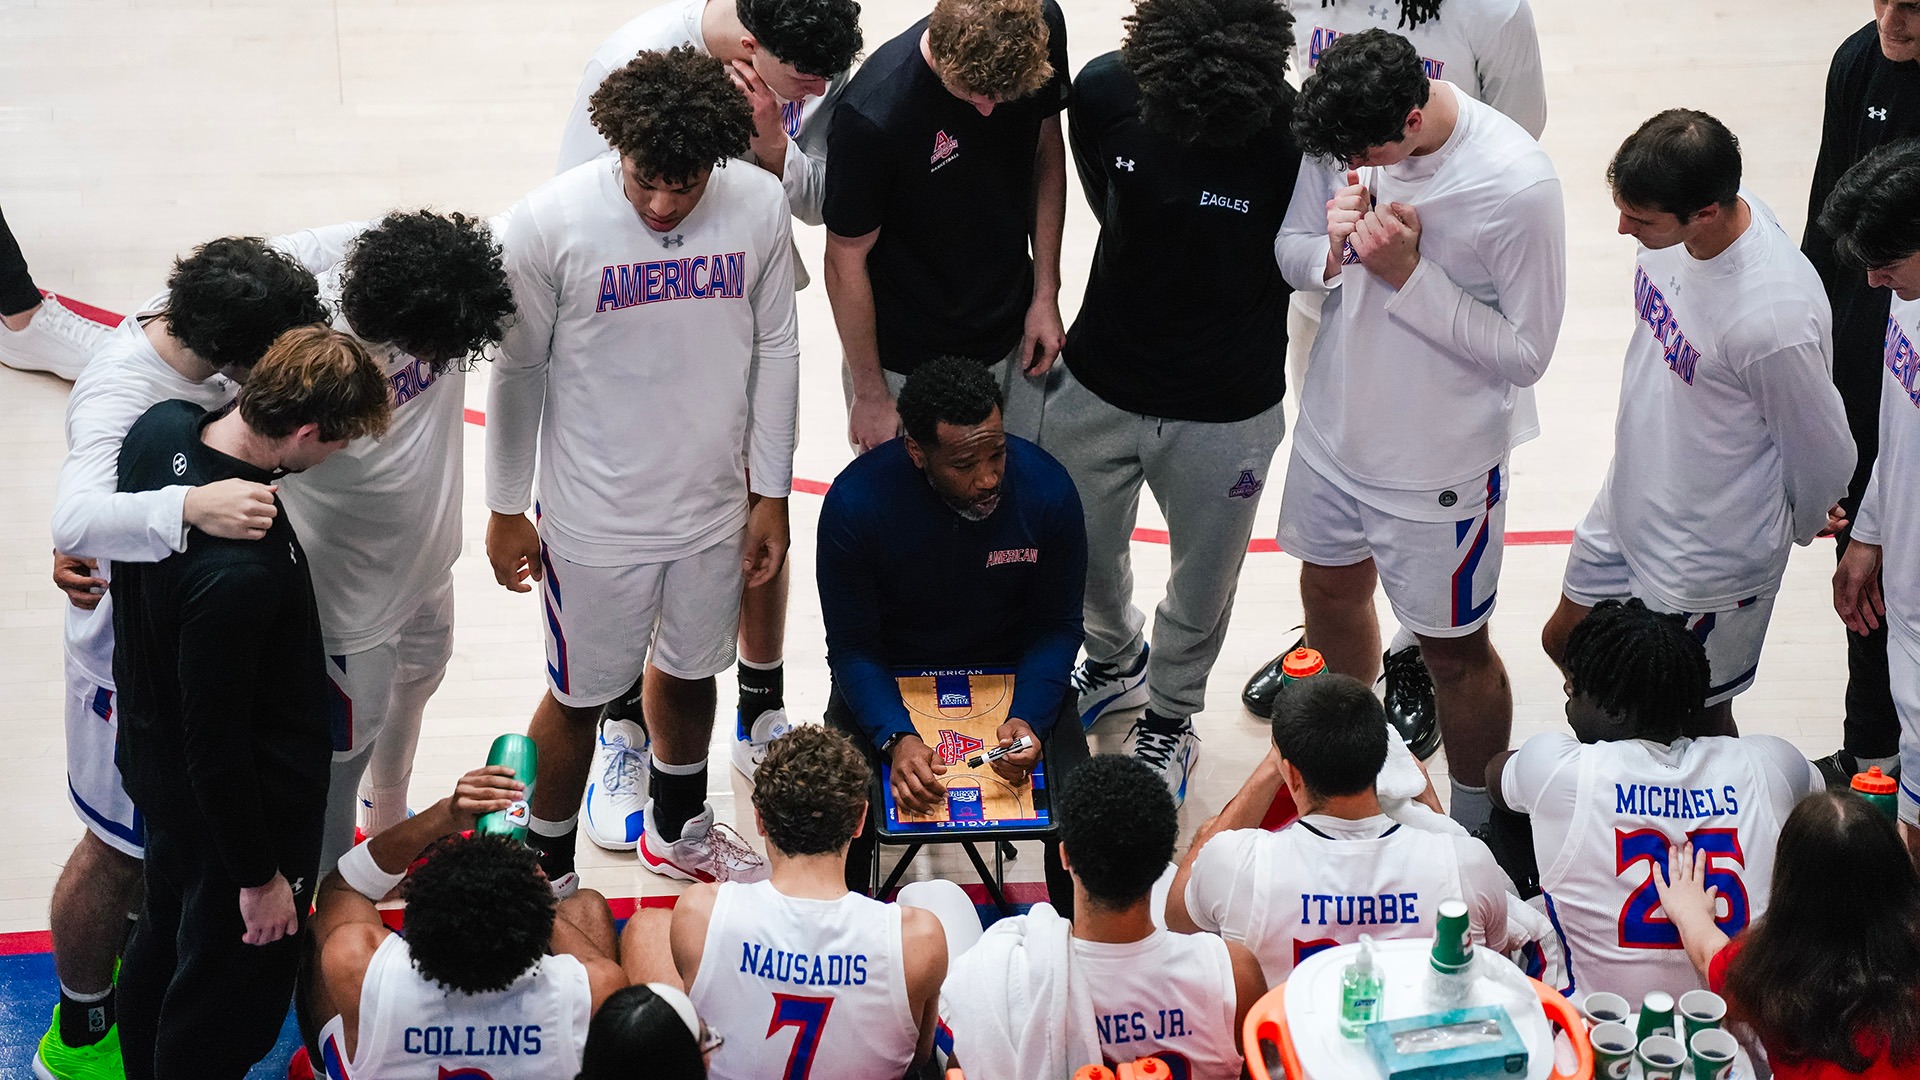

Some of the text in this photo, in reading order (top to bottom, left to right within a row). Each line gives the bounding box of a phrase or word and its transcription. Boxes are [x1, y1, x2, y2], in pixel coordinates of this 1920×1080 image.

[1200, 190, 1250, 214] EAGLES
[596, 252, 745, 313] AMERICAN
[985, 548, 1038, 568] AMERICAN
[920, 669, 983, 677] AMERICAN
[1615, 783, 1739, 819] MICHAELS
[936, 820, 999, 828] EAGLES
[1615, 827, 1751, 950] 25
[1301, 892, 1420, 926] ITURBE
[739, 942, 868, 985] NAUSADIS
[404, 1025, 542, 1056] COLLINS
[765, 992, 835, 1080] 7
[1153, 1008, 1193, 1040] JR.
